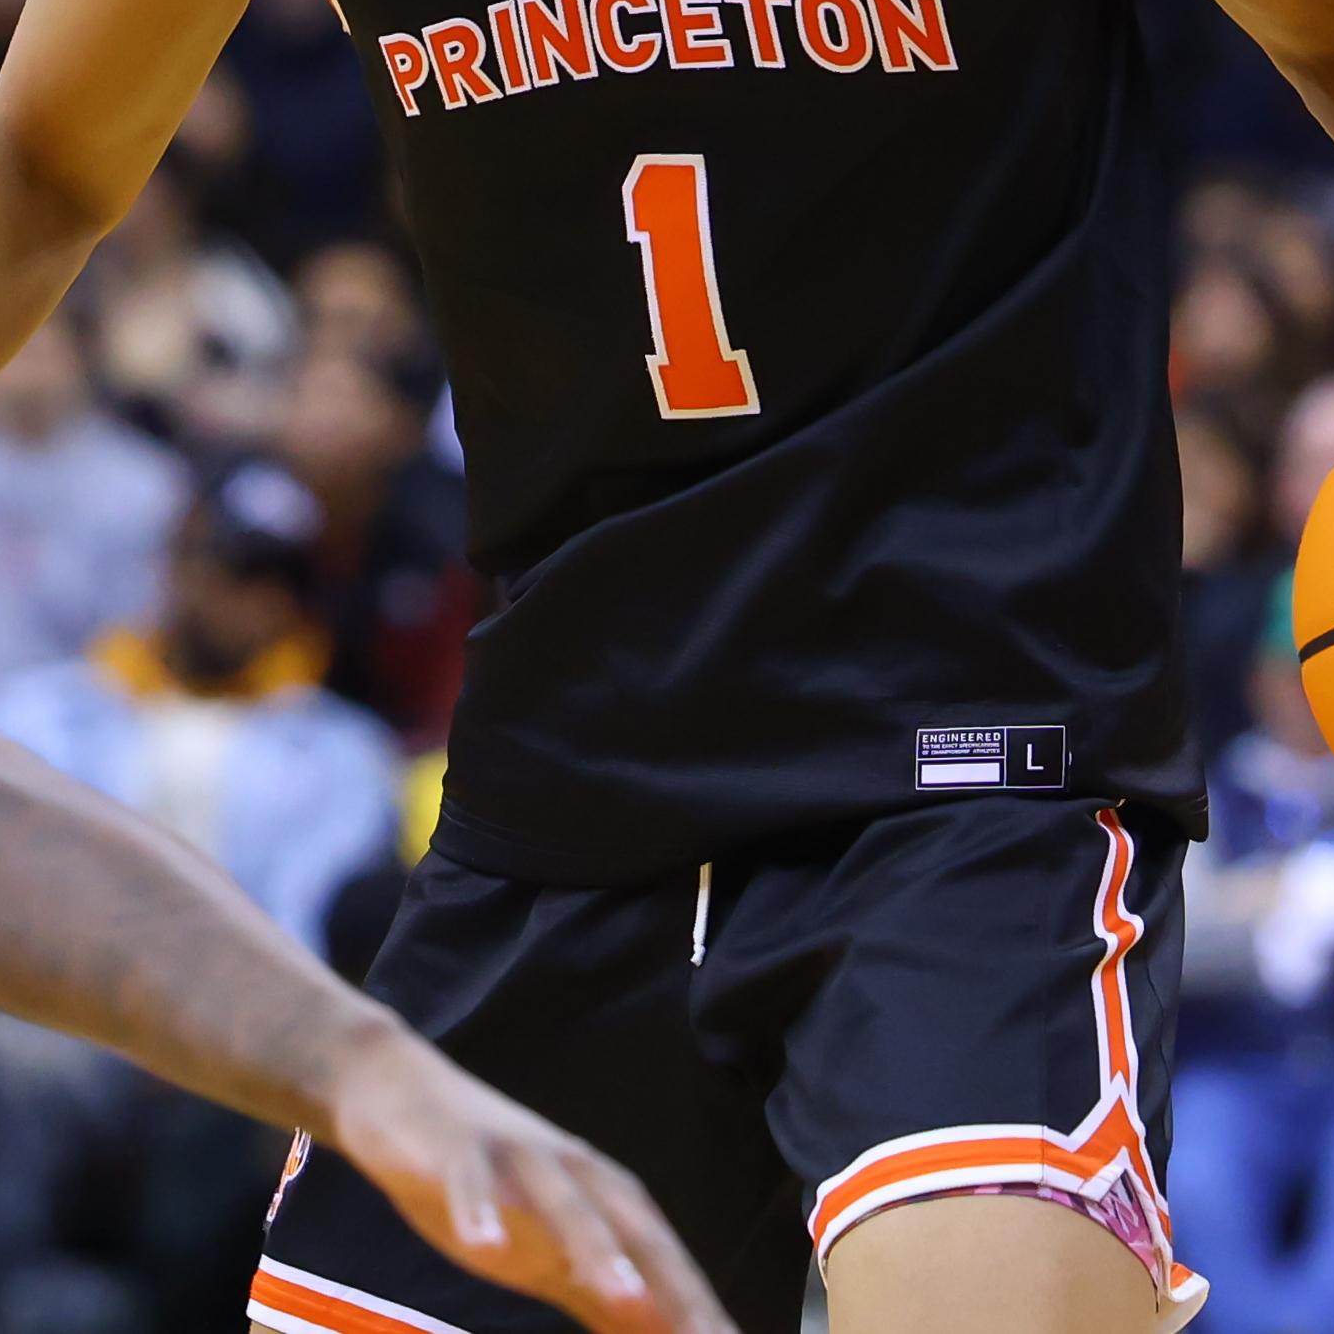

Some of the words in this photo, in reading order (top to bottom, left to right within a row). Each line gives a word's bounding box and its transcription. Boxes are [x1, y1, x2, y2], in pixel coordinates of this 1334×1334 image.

[622, 154, 761, 419] 1
[922, 732, 1001, 743] ENGINEERED
[1027, 743, 1044, 770] L
